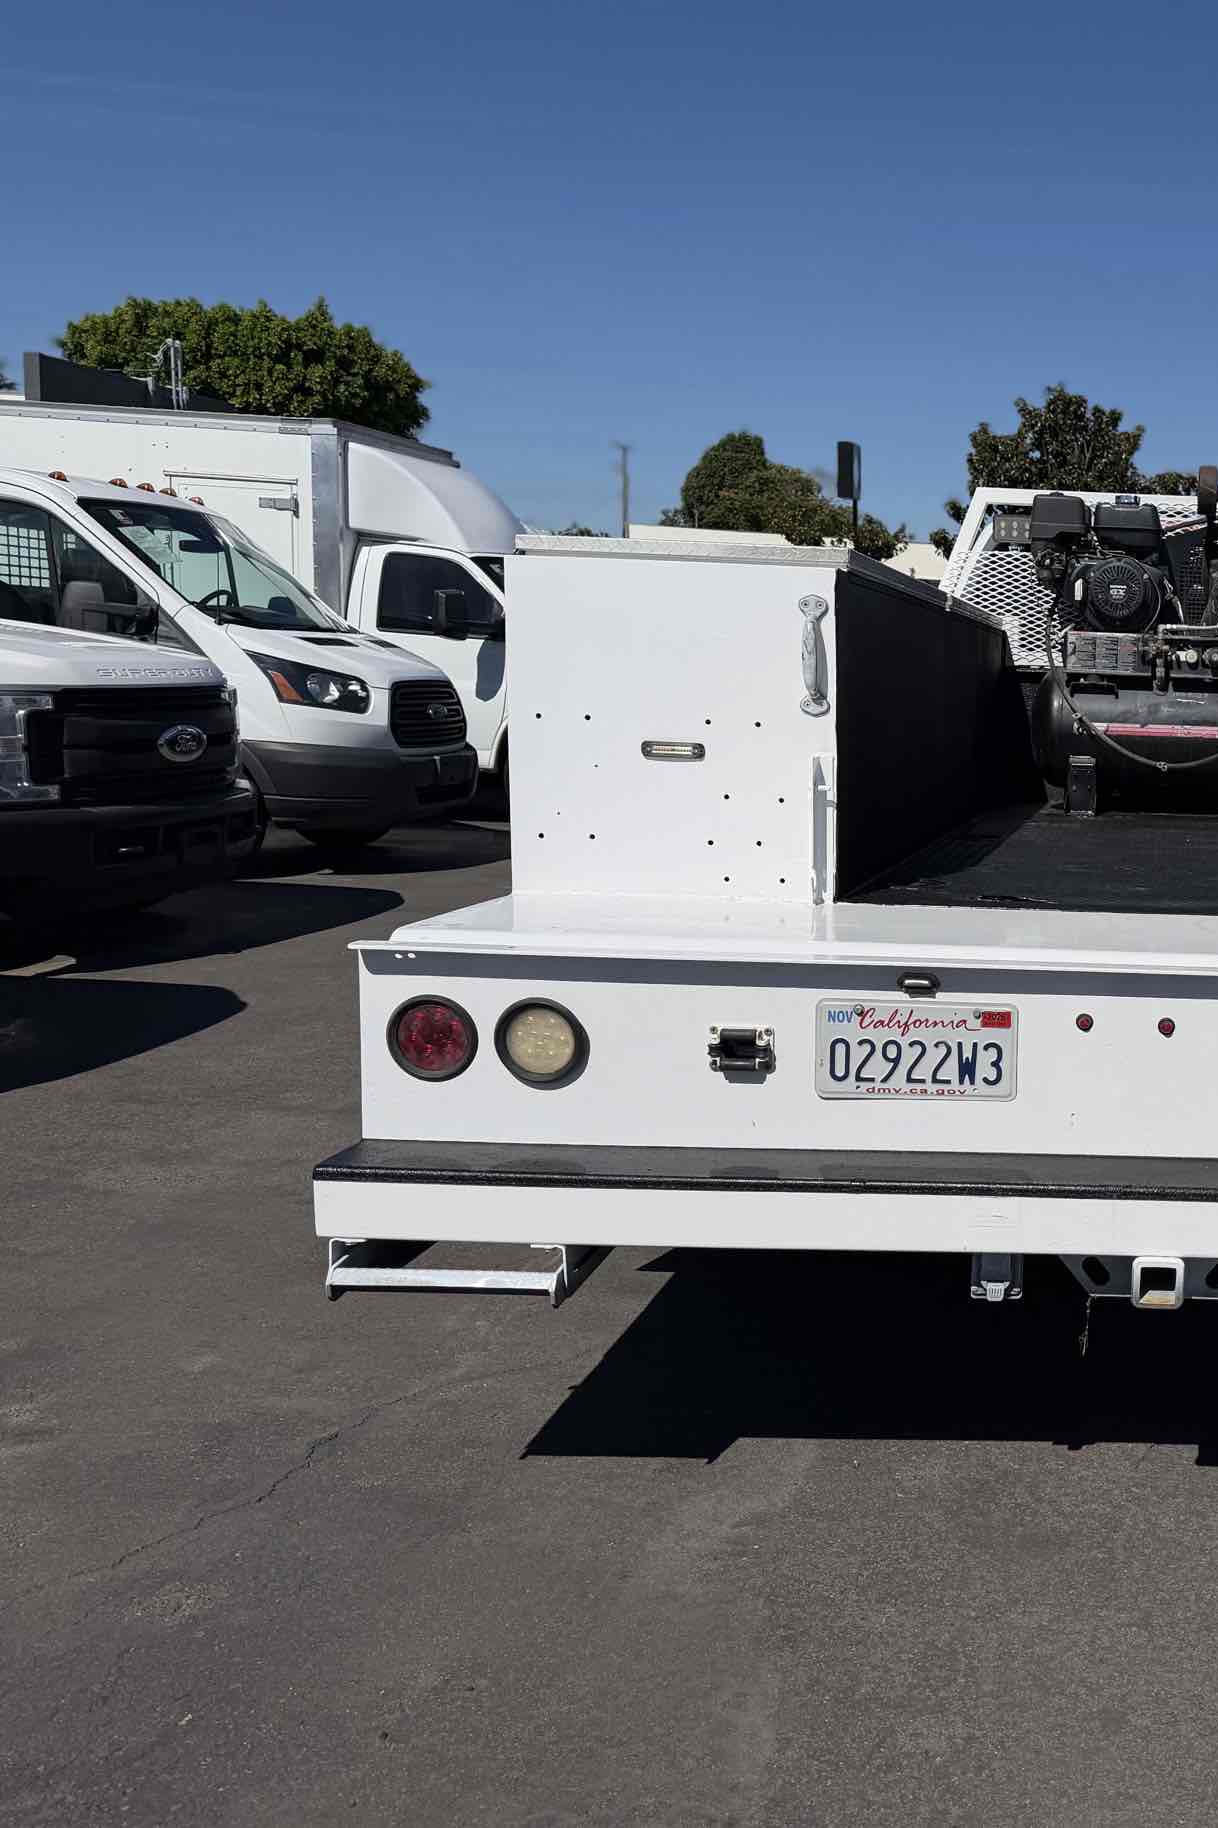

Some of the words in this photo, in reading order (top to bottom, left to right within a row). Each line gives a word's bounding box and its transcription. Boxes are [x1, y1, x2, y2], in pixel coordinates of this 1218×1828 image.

[175, 734, 197, 753] Ford
[827, 1010, 854, 1024] NOV
[859, 1007, 982, 1037] California
[828, 1037, 1003, 1086] 02922W3
[866, 1086, 967, 1096] dmv.ca.gov
